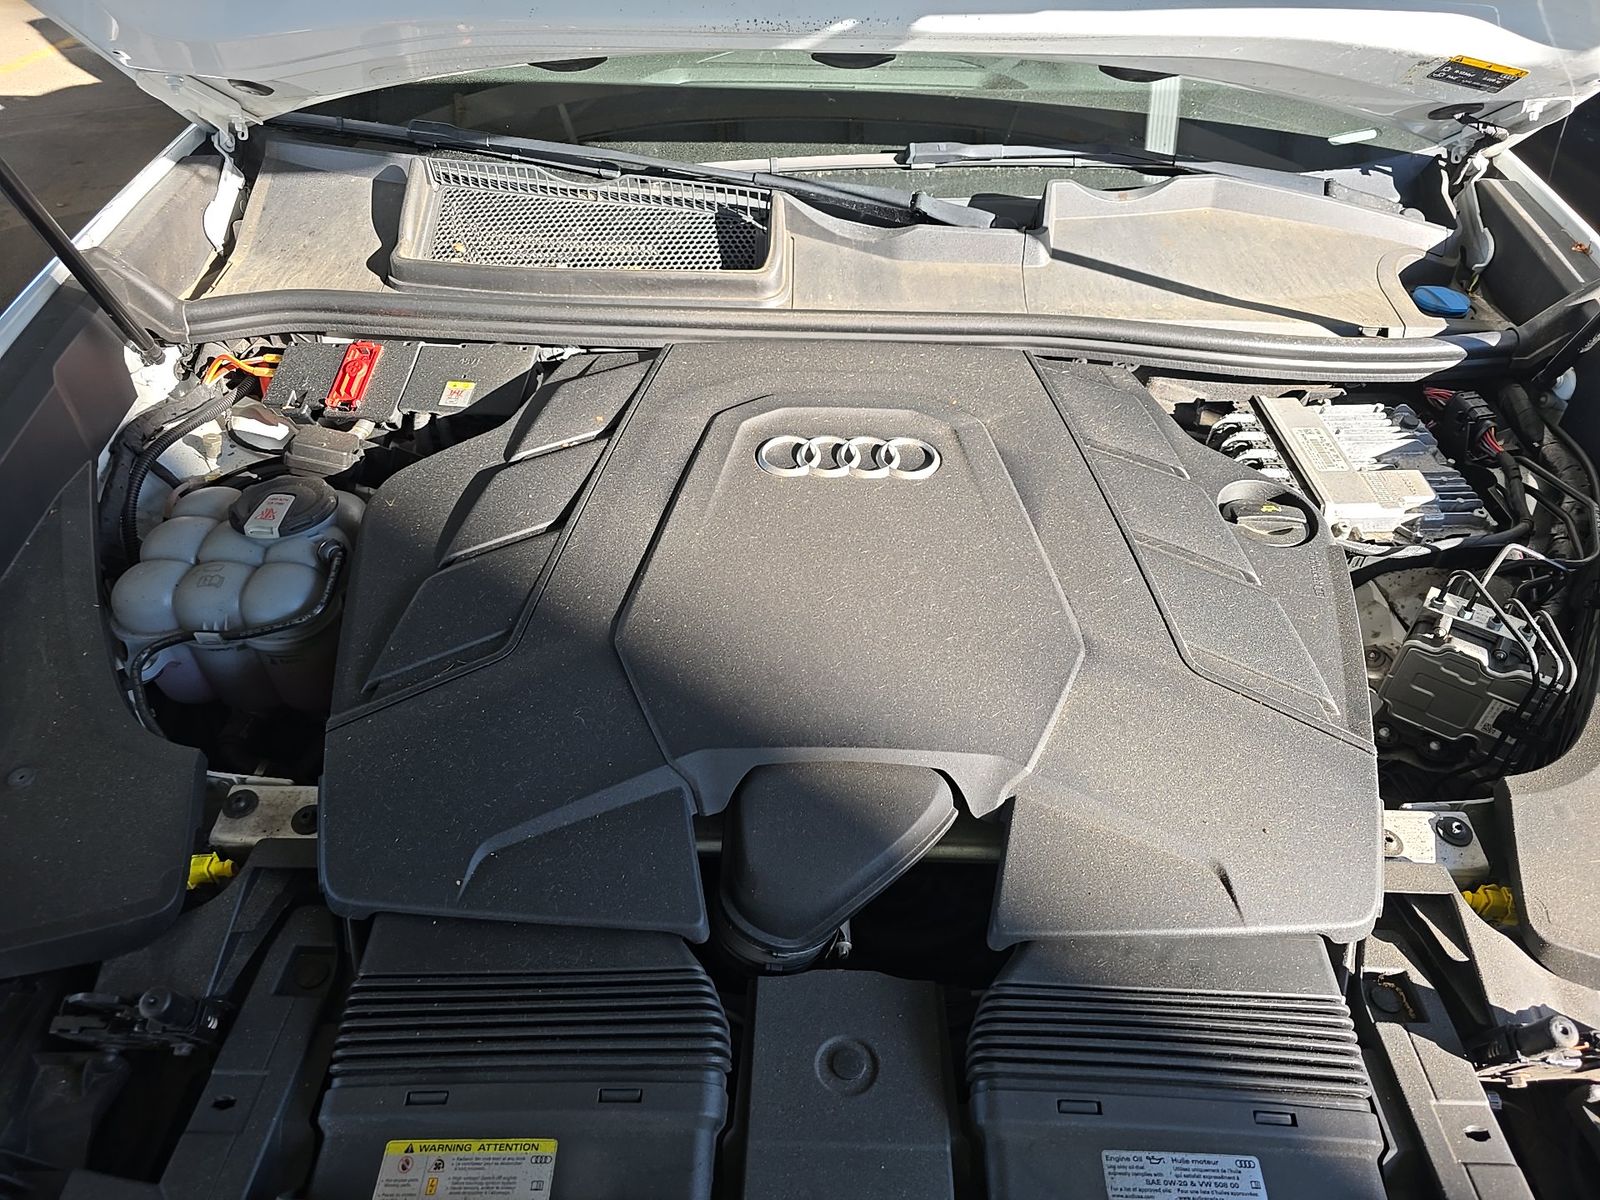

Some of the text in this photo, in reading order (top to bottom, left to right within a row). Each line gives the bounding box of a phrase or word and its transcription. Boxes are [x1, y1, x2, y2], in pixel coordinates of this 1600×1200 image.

[419, 1143, 540, 1152] WARNING ATTENTION
[1105, 1155, 1131, 1163] Engine
[1191, 1158, 1219, 1166] moteur
[1163, 1179, 1188, 1187] 0W-20
[1213, 1181, 1228, 1189] 508
